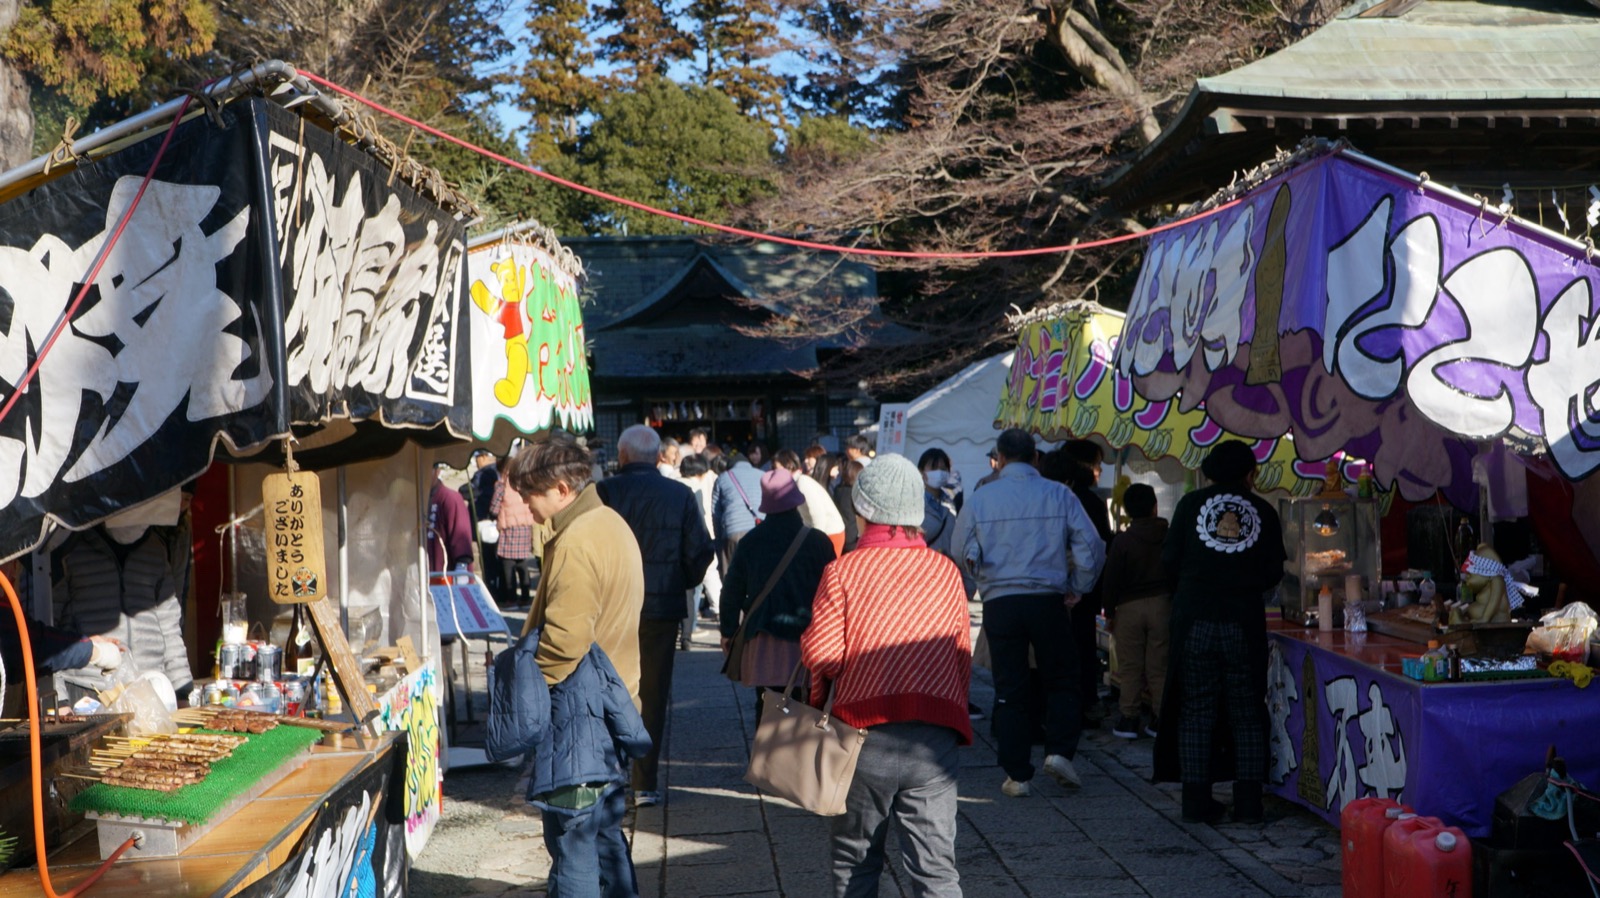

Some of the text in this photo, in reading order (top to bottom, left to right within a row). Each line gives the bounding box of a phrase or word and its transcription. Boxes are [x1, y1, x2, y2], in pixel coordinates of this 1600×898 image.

[275, 499, 289, 596] ございました
[290, 484, 304, 563] ありがとう
